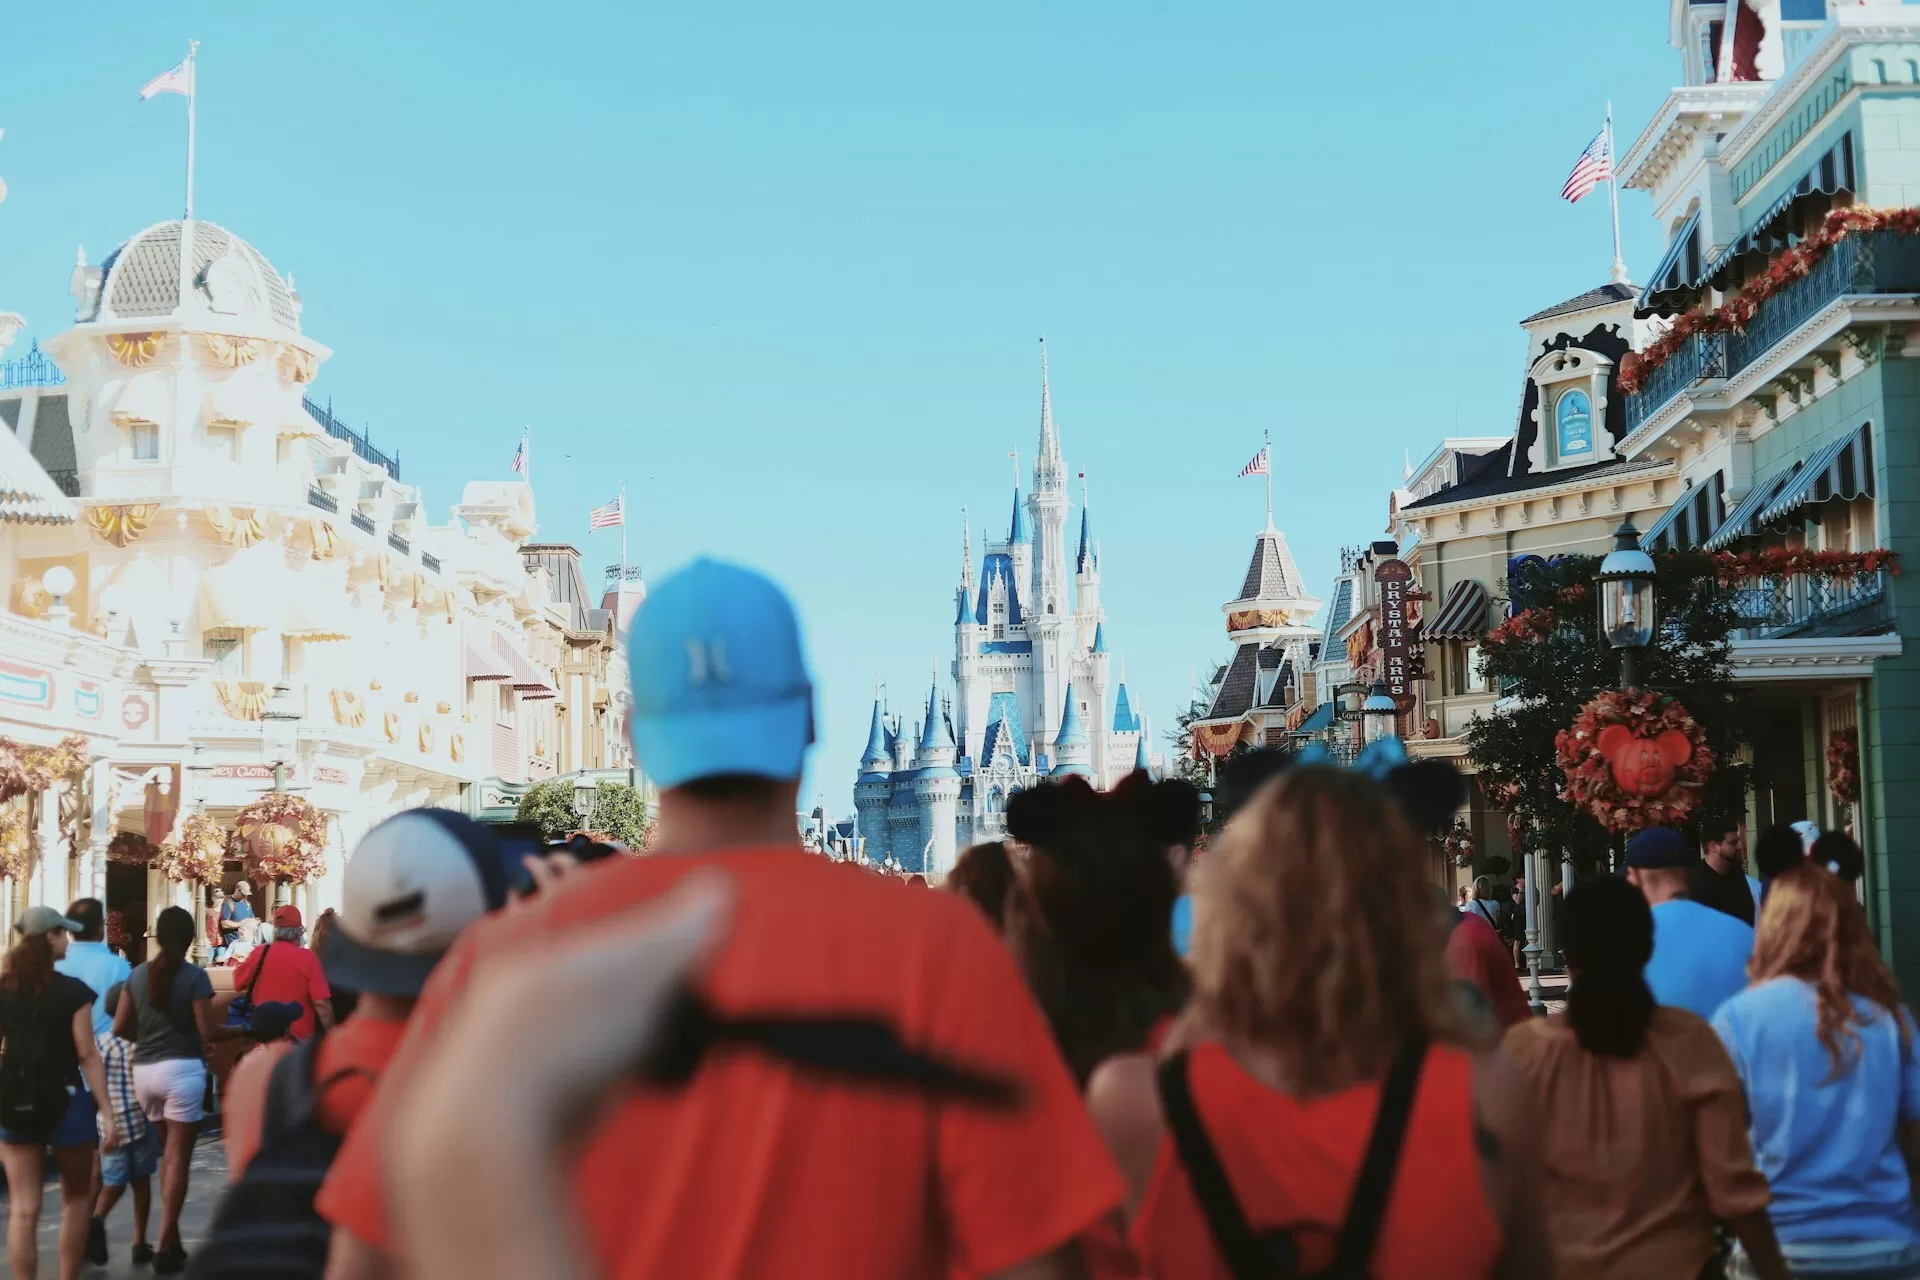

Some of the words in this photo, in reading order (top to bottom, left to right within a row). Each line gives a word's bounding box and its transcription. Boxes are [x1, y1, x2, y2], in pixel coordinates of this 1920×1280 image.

[1387, 581, 1402, 647] CRYSTAL
[1389, 656, 1404, 694] ARTS
[1342, 712, 1361, 720] COFFE
